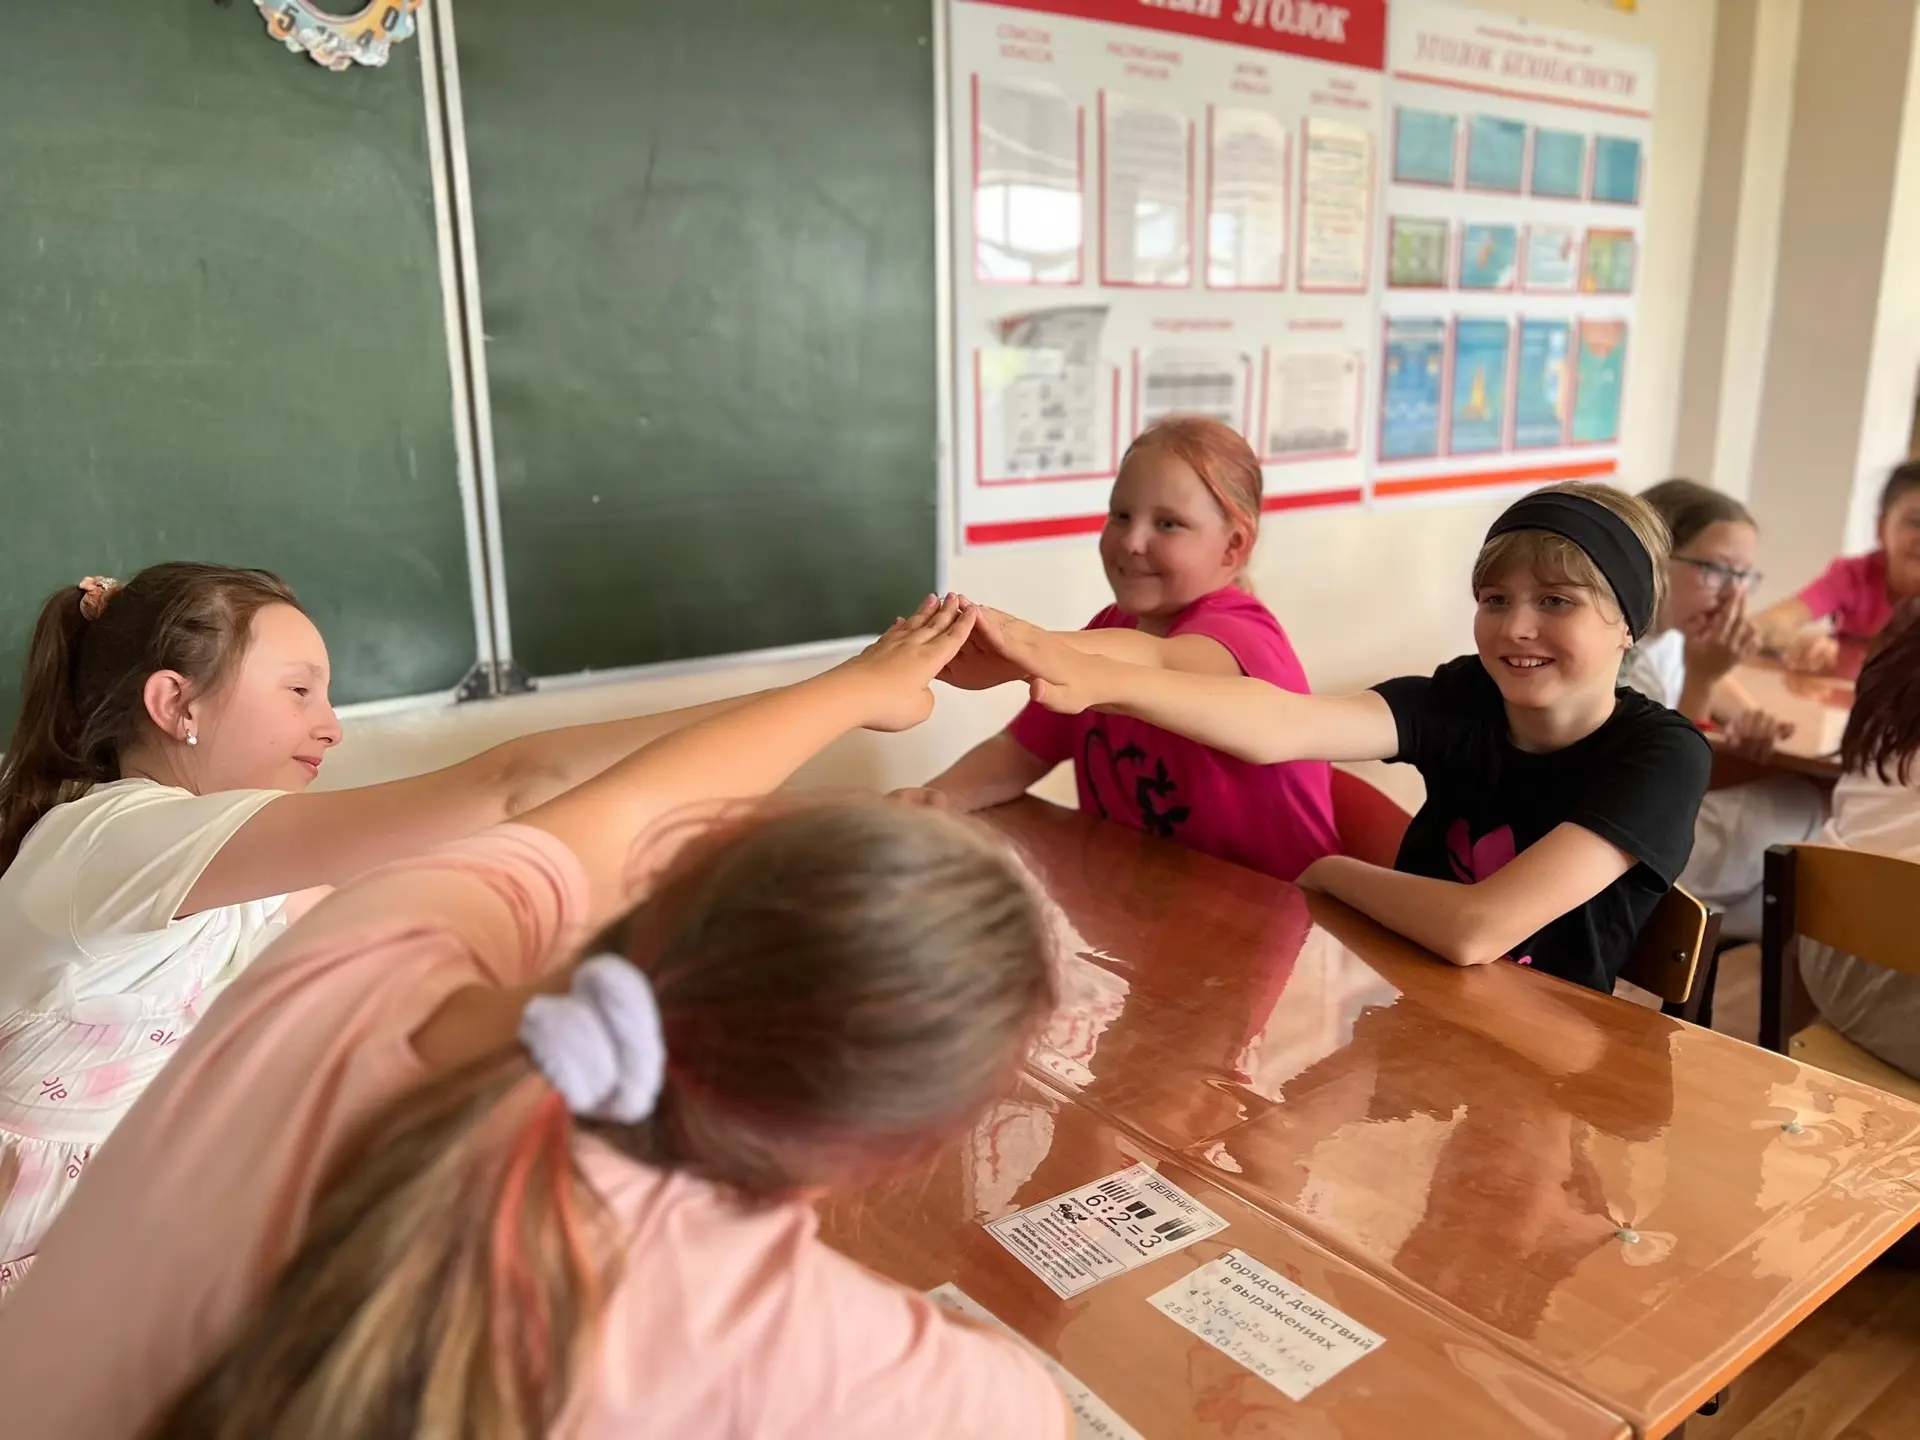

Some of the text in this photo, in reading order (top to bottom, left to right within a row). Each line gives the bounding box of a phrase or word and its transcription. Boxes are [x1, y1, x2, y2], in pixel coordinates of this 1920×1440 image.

[278, 5, 299, 32] 5
[1233, 0, 1350, 43] УГОЛОК
[1085, 1194, 1107, 1206] 6
[1106, 1211, 1131, 1225] 2
[1138, 1234, 1161, 1248] 3
[1146, 1180, 1198, 1214] ДЕЛЕНИЕ
[1217, 1252, 1373, 1350] Порядок действий
[1219, 1276, 1335, 1350] в выражениях
